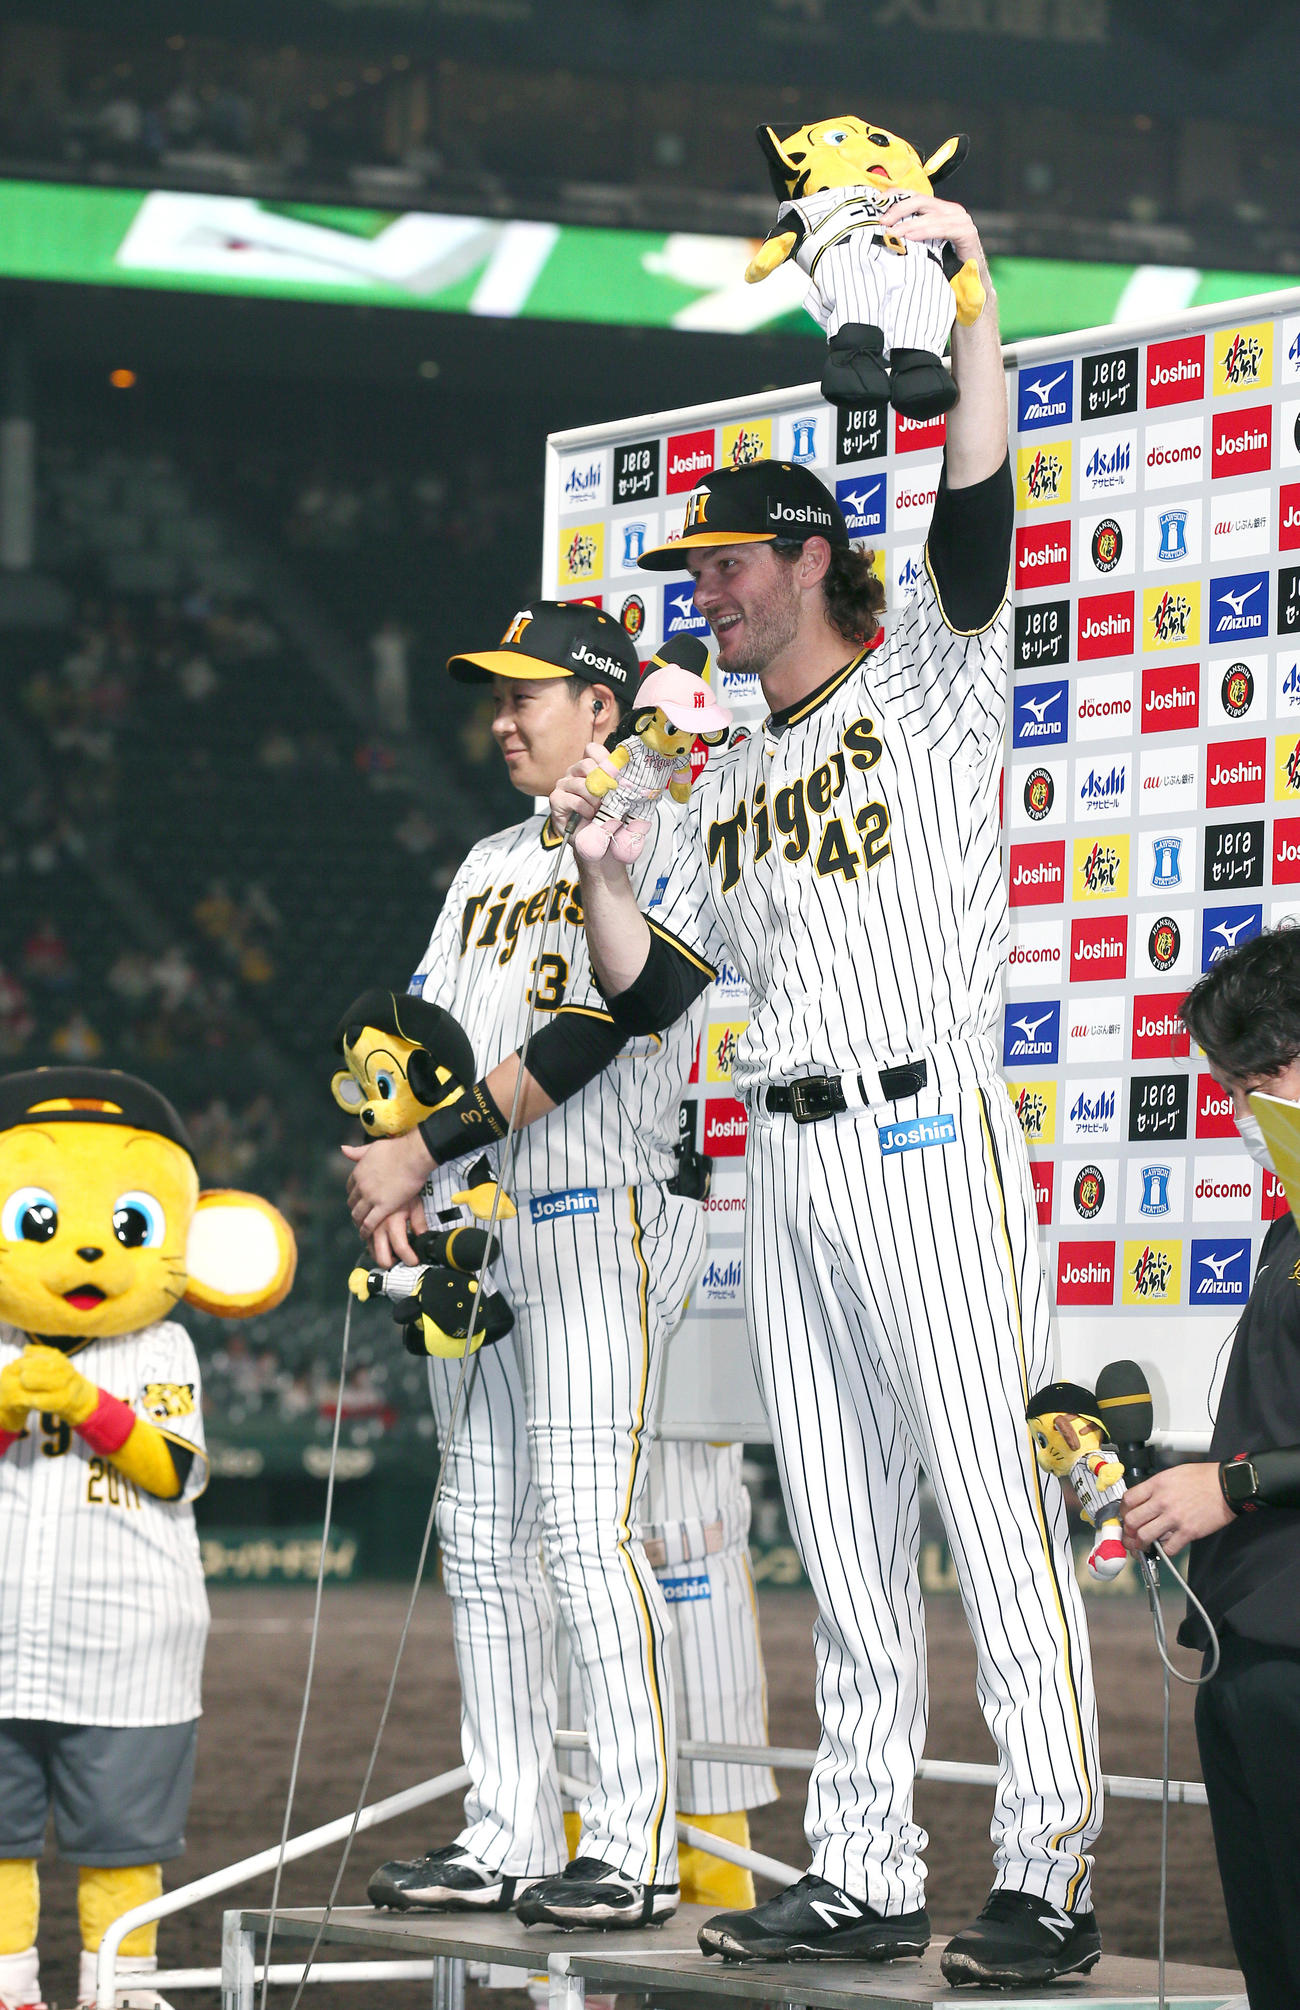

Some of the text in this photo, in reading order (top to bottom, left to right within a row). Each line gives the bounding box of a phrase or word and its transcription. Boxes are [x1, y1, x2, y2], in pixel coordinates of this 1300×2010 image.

[1150, 359, 1201, 386] Joshin
[1216, 429, 1267, 456] Joshin
[669, 450, 712, 475] Joshin
[1086, 442, 1130, 478] Asahi
[1147, 445, 1201, 466] docomo
[565, 463, 601, 492] Asahi
[896, 491, 937, 509] docom
[769, 503, 832, 526] Joshin
[1159, 510, 1187, 523] LAWSON
[1214, 521, 1234, 535] au
[1235, 517, 1267, 531] じぶん銀行
[1095, 519, 1120, 538] HANSHIN
[1019, 543, 1067, 568] Joshin
[1082, 613, 1130, 639] Joshin
[571, 645, 627, 683] Joshin
[1225, 665, 1251, 682] HANSHIN
[1078, 699, 1131, 719] docomo
[1145, 686, 1196, 711] Joshin
[1027, 768, 1052, 785] HANSHIN
[1080, 765, 1125, 798] Asahi
[1143, 773, 1194, 789] au じぶん銀行
[1210, 760, 1262, 786] Joshin
[708, 716, 883, 895] Tigers
[814, 801, 891, 883] 42
[1154, 838, 1181, 850] LAWSON
[1013, 862, 1061, 886] Joshin
[459, 878, 585, 967] Tigers
[1153, 918, 1177, 935] HANSHIN
[1009, 945, 1061, 965] docomo
[1074, 935, 1123, 962] Joshin
[526, 952, 569, 1013] 3
[1071, 1023, 1120, 1038] au じぶん銀行
[1070, 1090, 1115, 1121] Asahi
[882, 1121, 954, 1151] Joshin
[1078, 1166, 1102, 1184] HANSHIN
[1143, 1167, 1170, 1179] LAWSON
[1195, 1179, 1251, 1198] docomo
[533, 1192, 597, 1219] Joshin
[703, 1260, 741, 1287] Asahi
[1061, 1262, 1111, 1284] Joshin
[661, 1580, 710, 1599] oshin
